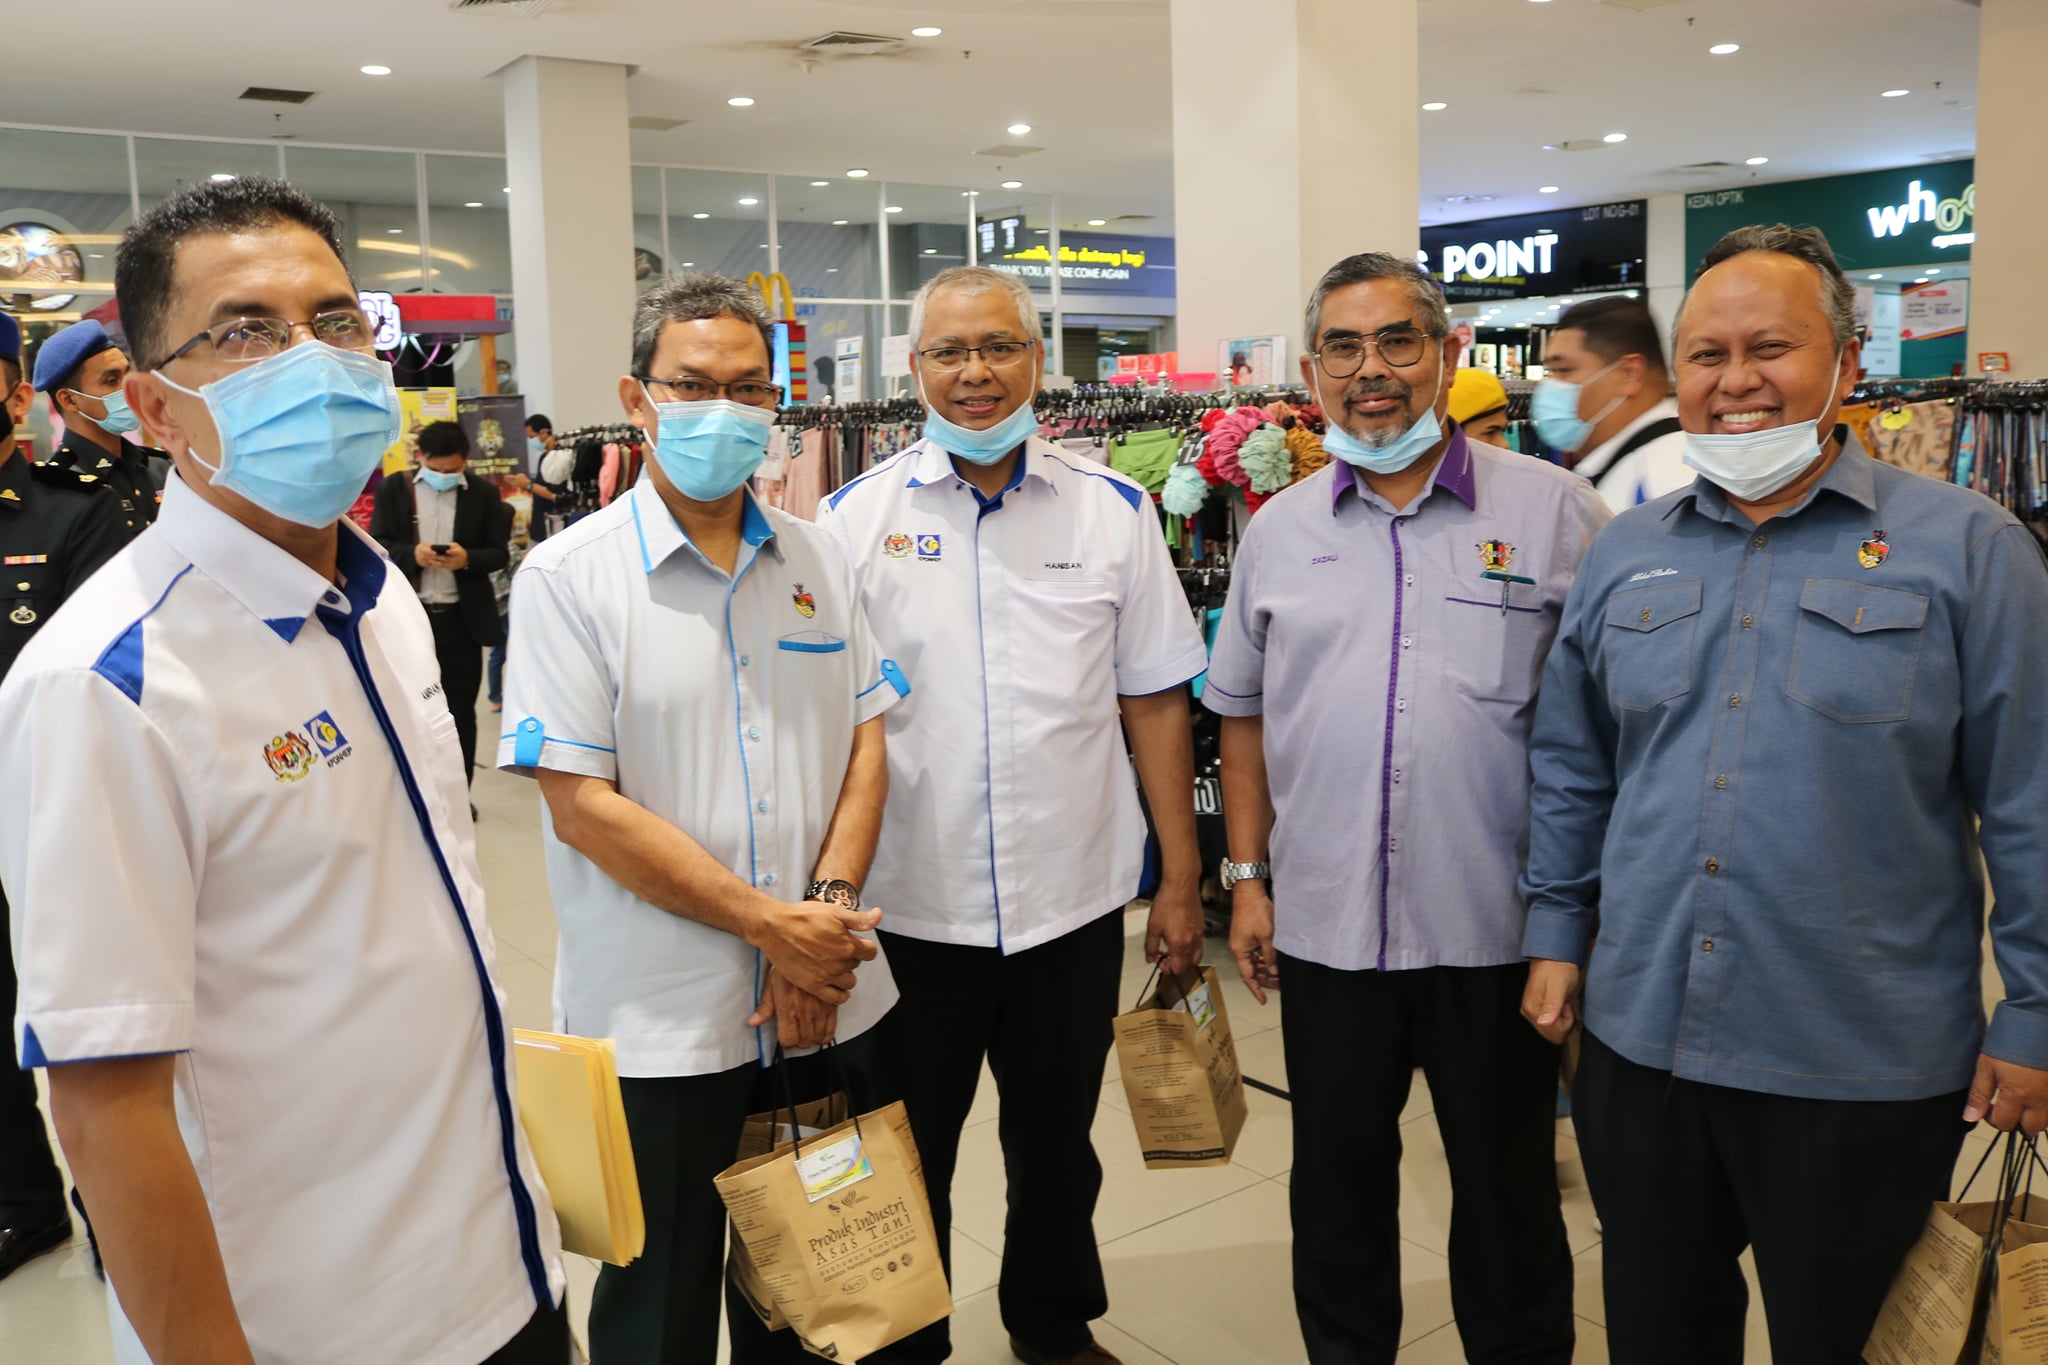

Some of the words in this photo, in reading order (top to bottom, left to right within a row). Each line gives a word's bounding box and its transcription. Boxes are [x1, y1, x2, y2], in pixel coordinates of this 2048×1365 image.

[1582, 206, 1600, 221] LOT
[1716, 191, 1744, 206] OPTIK
[1045, 266, 1074, 278] PASE
[1102, 268, 1129, 280] AGAIN
[1443, 233, 1558, 283] POINT
[808, 1217, 855, 1252] Produk
[853, 1196, 908, 1232] Industri
[816, 1238, 858, 1266] Asas
[865, 1213, 911, 1240] Tani
